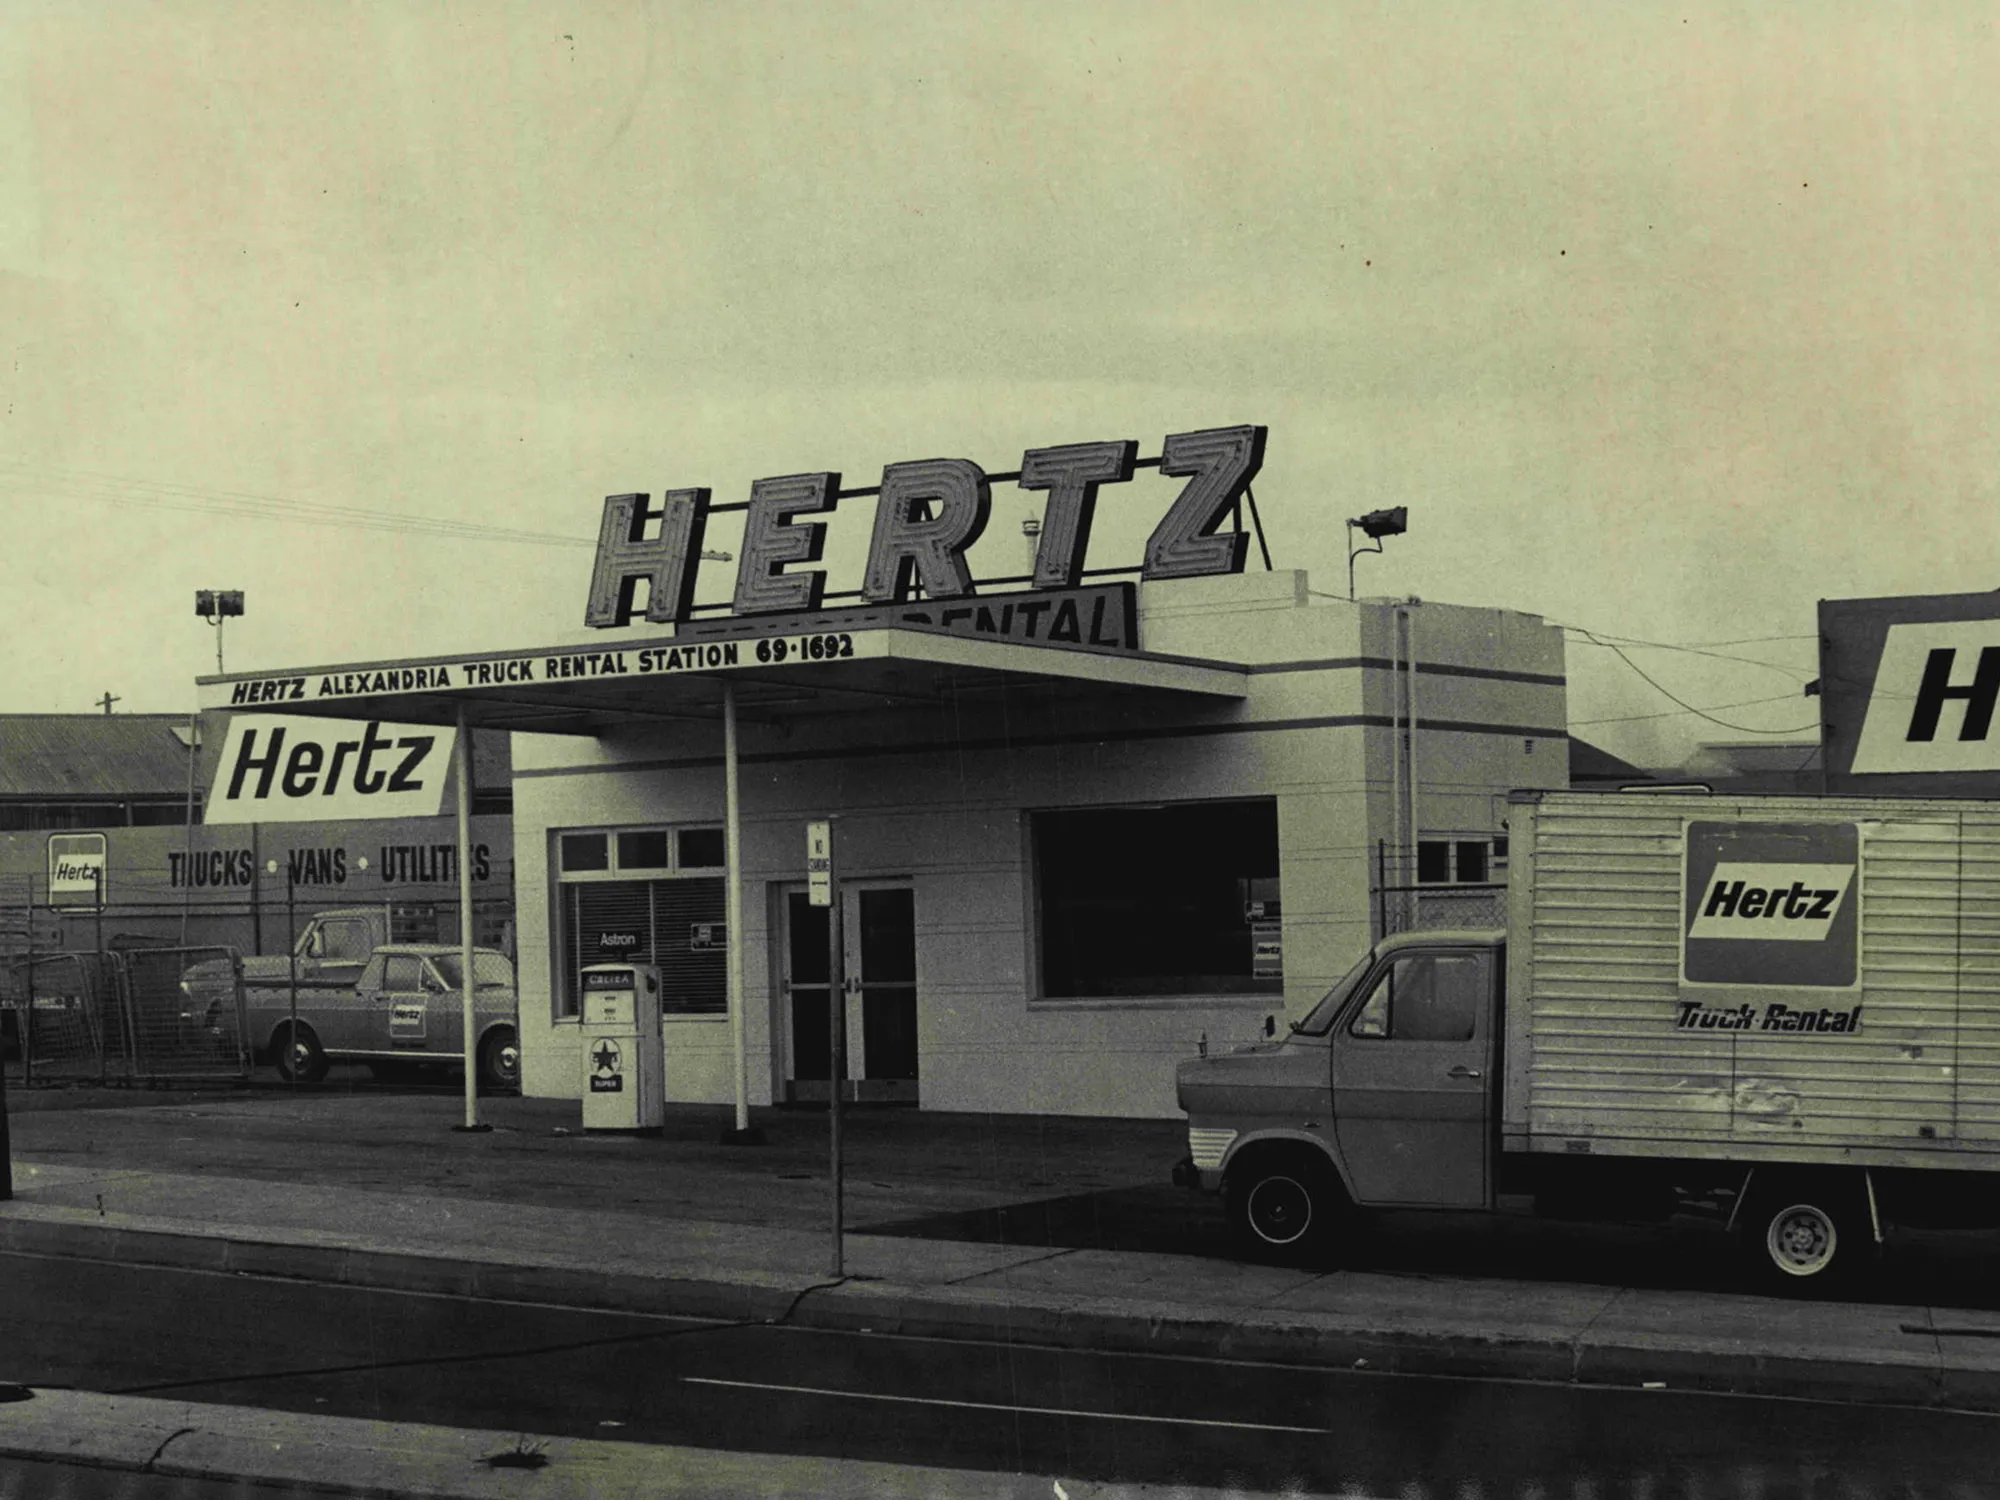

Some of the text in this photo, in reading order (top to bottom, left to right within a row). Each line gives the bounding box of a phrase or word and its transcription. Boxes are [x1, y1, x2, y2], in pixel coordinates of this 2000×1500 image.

[585, 425, 1268, 628] HERTZ
[231, 678, 305, 704] HERTZ
[318, 667, 451, 697] ALEXANDRIA
[464, 660, 534, 685] TRUCK
[546, 653, 628, 679] RENTAL
[639, 643, 738, 672] STATION
[226, 721, 435, 800] Hertz
[288, 848, 347, 885] VANS
[1703, 881, 1839, 919] Hertz
[600, 932, 636, 946] Astron
[1678, 1002, 1863, 1033] Truck Rental
